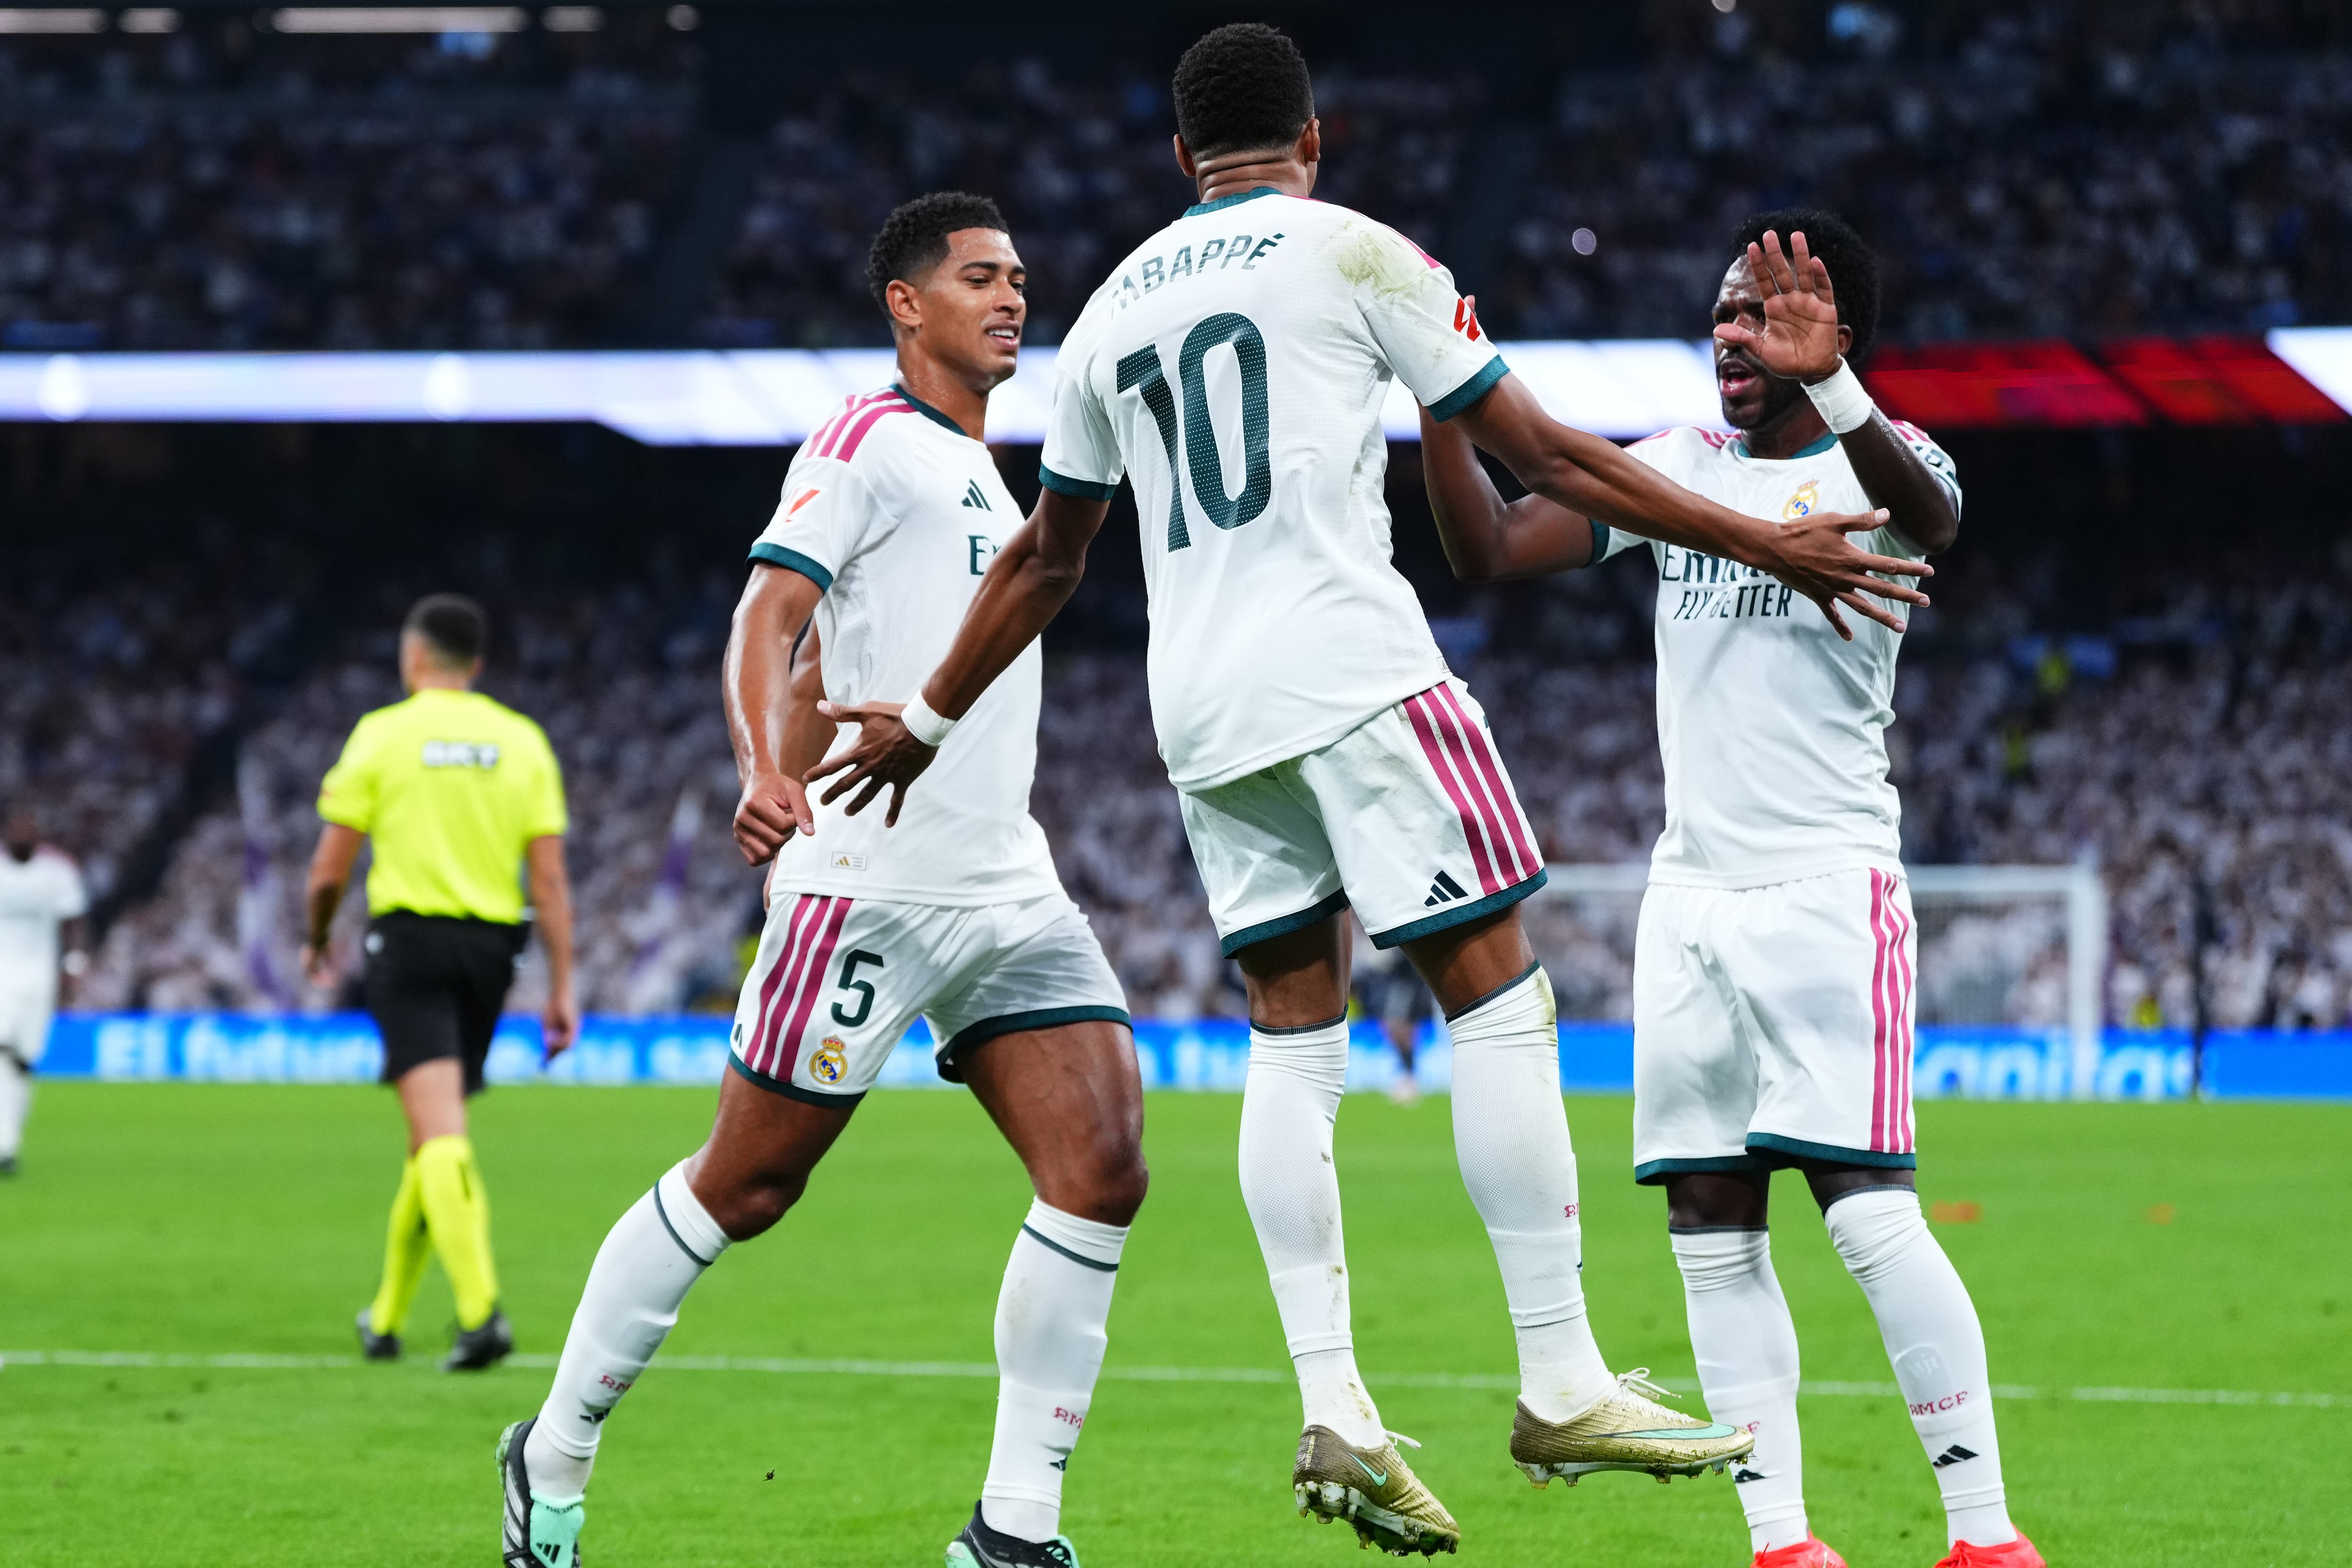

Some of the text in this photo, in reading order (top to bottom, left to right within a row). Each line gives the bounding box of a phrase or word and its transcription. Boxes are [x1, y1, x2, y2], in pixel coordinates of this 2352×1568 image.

[1116, 312, 1271, 553] 10
[1673, 583, 1793, 619] FLY BETTER
[830, 949, 884, 1028] 5
[1909, 1391, 1968, 1415] RMCF
